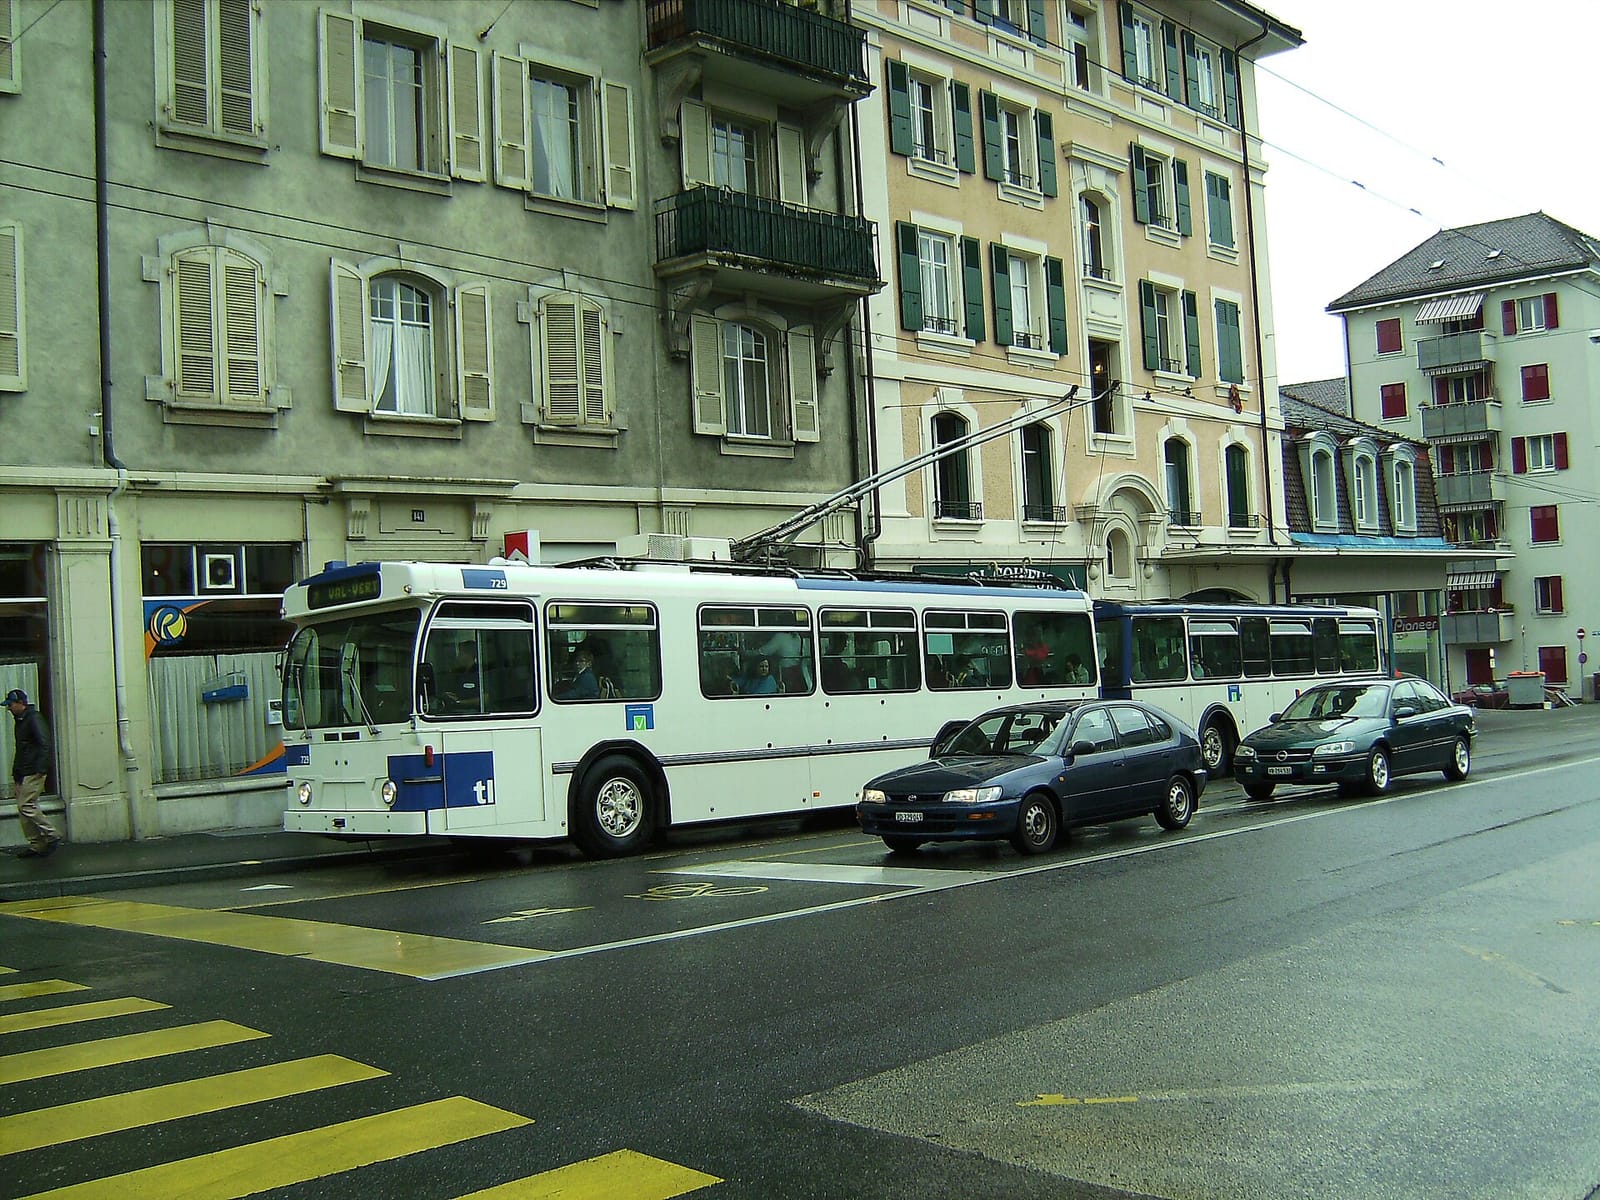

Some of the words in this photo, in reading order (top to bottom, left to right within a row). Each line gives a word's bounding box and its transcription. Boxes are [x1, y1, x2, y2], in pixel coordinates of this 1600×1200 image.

[413, 511, 424, 521] 141
[490, 579, 506, 588] 729
[1394, 618, 1437, 632] Pioneer
[473, 779, 494, 804] tl
